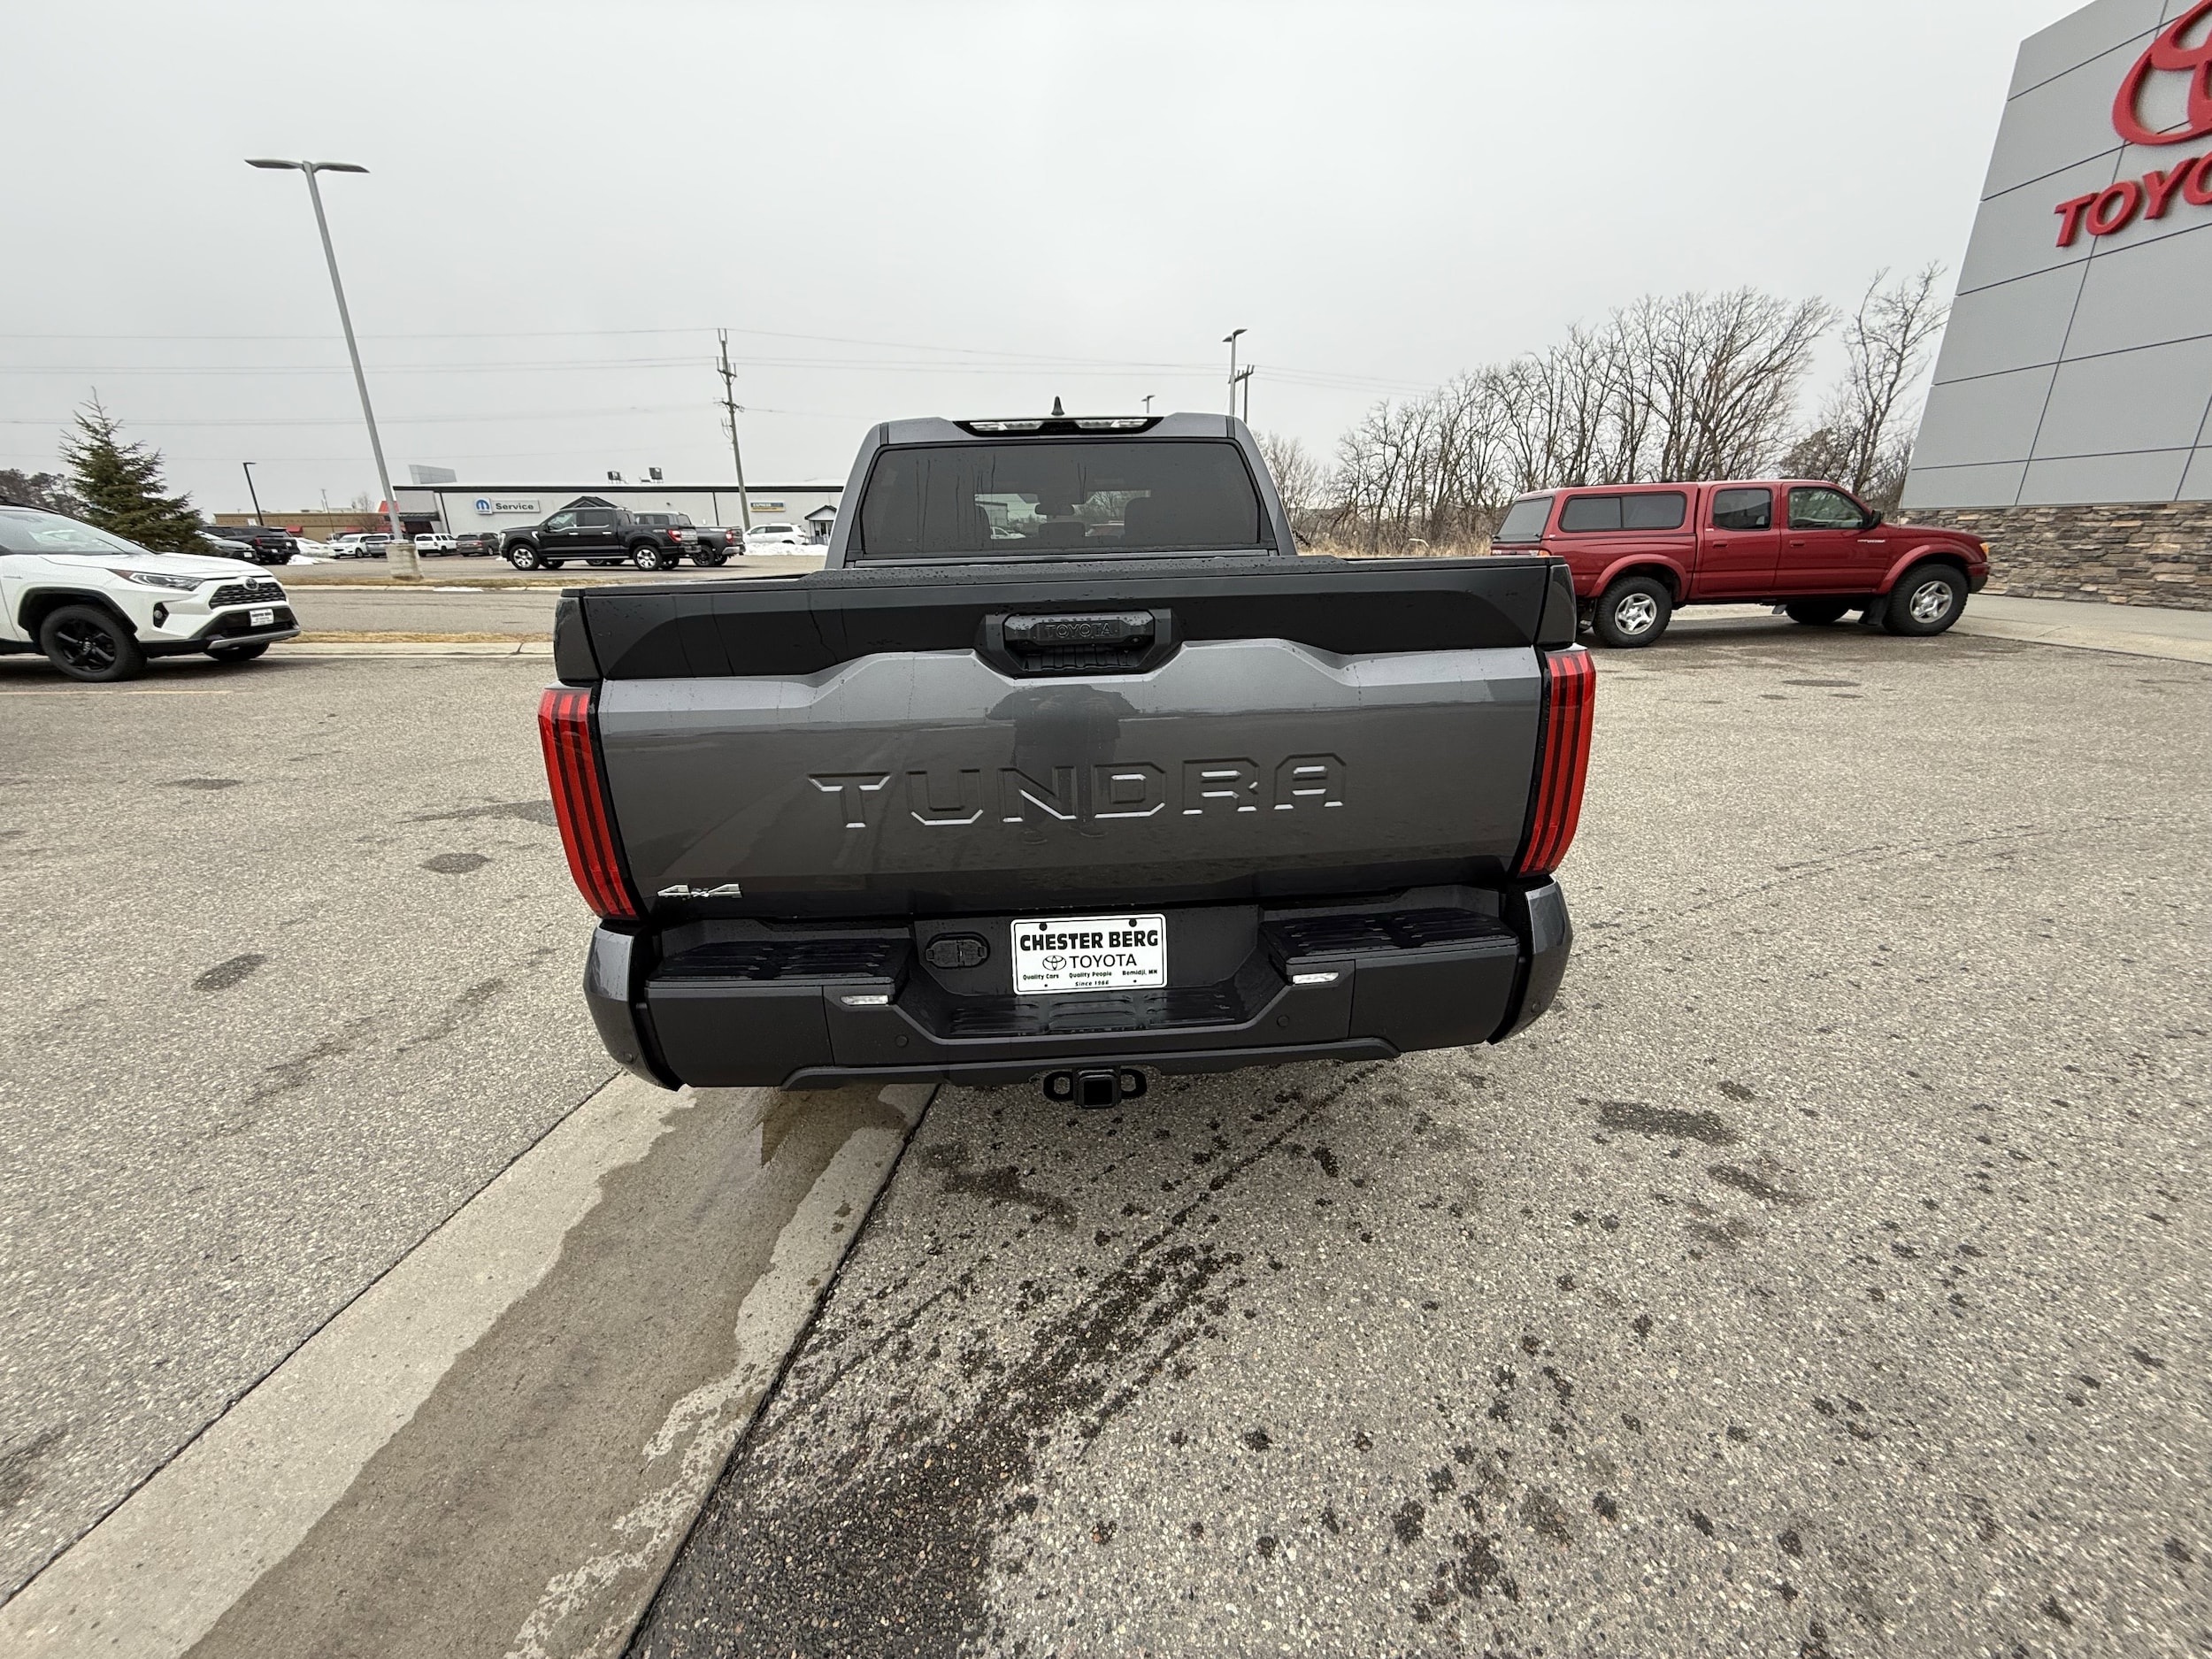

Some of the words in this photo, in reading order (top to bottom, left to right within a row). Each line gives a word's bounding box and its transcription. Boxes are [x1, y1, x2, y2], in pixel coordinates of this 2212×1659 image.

[1044, 622, 1113, 639] TOYOTA
[807, 752, 1348, 828] TUNDRA
[1019, 932, 1103, 951] CHESTER
[1109, 930, 1158, 948] BERG
[1069, 953, 1137, 969] TOYOTA
